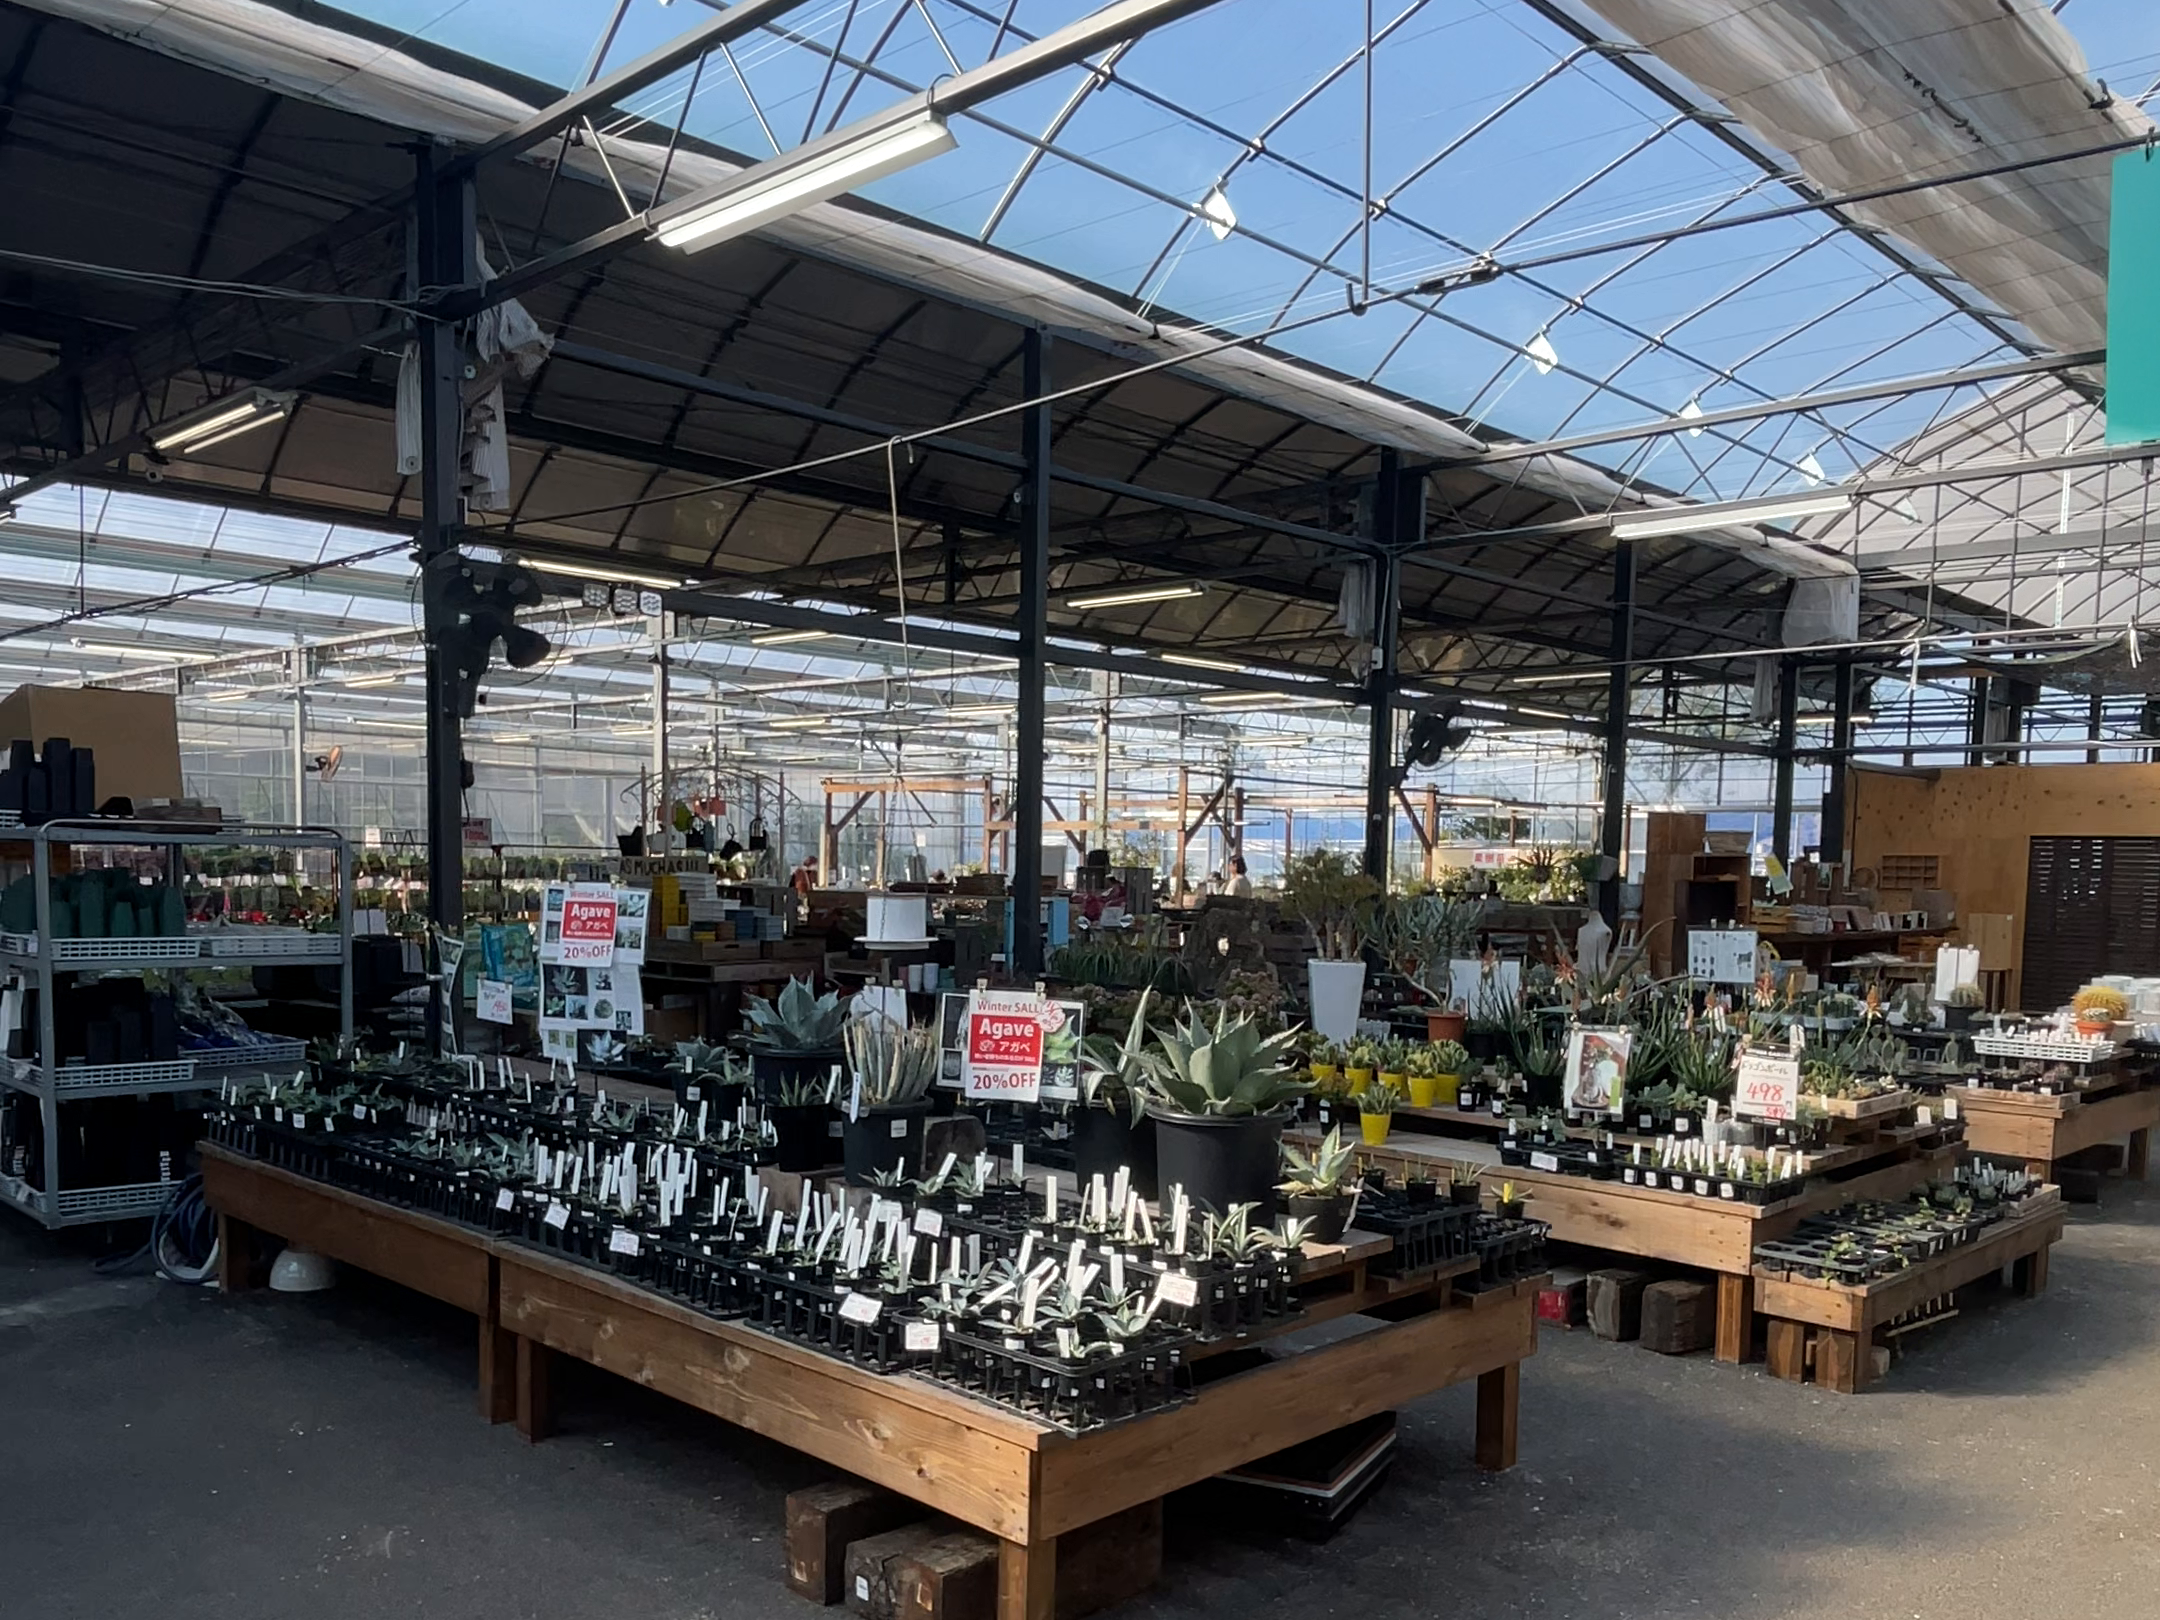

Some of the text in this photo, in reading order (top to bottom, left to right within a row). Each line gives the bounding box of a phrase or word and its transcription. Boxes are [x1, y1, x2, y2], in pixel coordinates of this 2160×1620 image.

[571, 903, 612, 921] Agave
[563, 944, 612, 959] 20%OFF
[977, 1000, 1013, 1013] Winter
[979, 1017, 1034, 1039] Agave
[999, 1041, 1031, 1053] アガベ
[972, 1072, 1037, 1090] 20%OFF
[1747, 1082, 1784, 1102] 498
